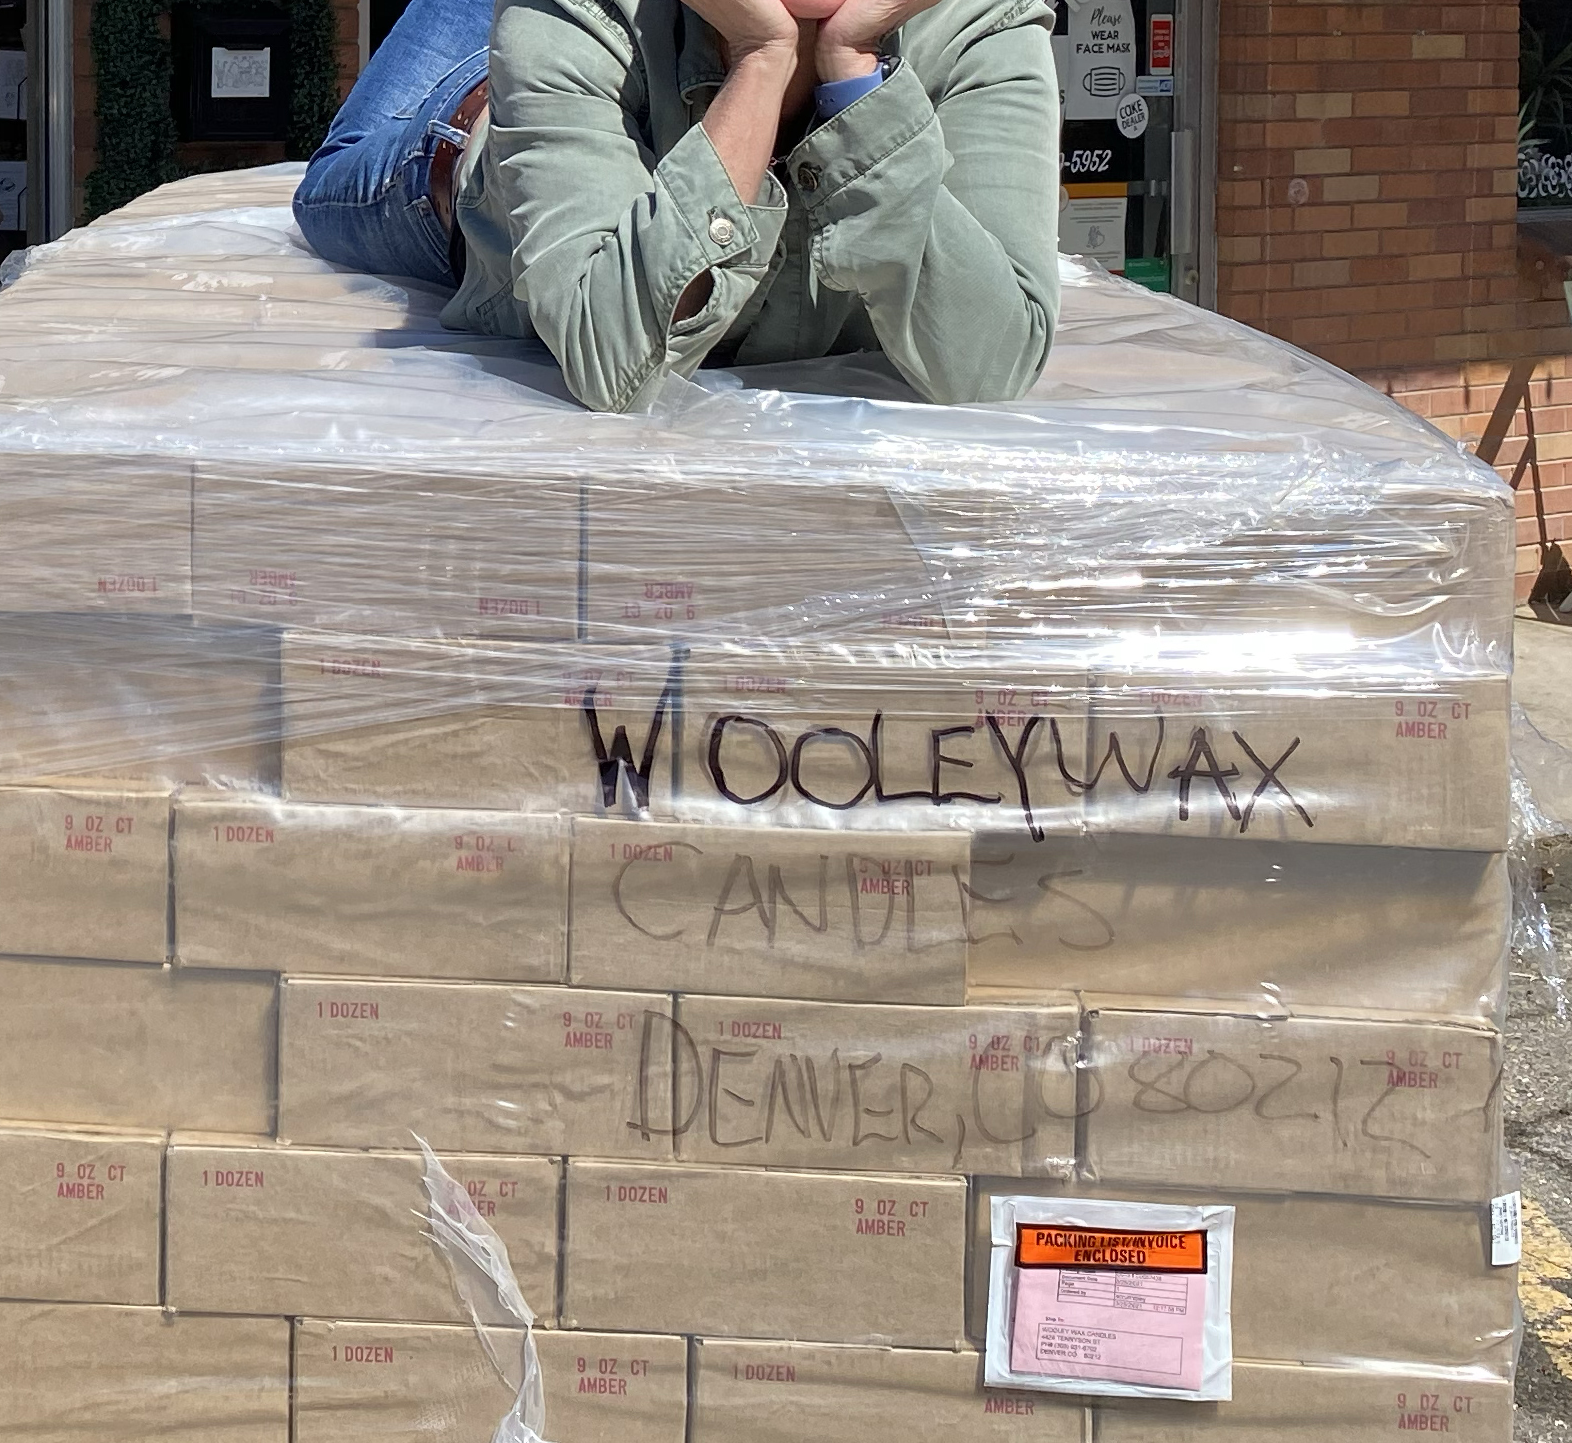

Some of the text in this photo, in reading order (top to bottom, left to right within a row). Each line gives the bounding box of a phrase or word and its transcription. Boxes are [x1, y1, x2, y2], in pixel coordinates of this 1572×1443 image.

[1090, 6, 1122, 26] Please
[1091, 30, 1119, 41] WEAR
[1076, 42, 1131, 54] FACE MASK
[1119, 99, 1143, 120] COKE
[1121, 112, 1146, 130] DEALER
[644, 582, 695, 600] AMBER
[975, 689, 1050, 707] 9 OZ CT
[1394, 700, 1472, 720] 9 OZ CT
[1395, 721, 1448, 739] AMBER
[65, 815, 134, 835] 9 OZ CT
[226, 826, 274, 843] DOZEN
[65, 835, 113, 853] AMBER
[622, 844, 673, 862] DOZEN
[456, 854, 504, 873] AMBER
[859, 859, 934, 877] 9 OZ CT
[860, 877, 911, 896] AMBER
[329, 1003, 379, 1020] DOZEN
[563, 1011, 635, 1031] 9 OZ CT
[731, 1021, 782, 1040] DOZEN
[564, 1031, 614, 1050] AMBER
[969, 1034, 1041, 1053] 9 OZ CT
[1141, 1037, 1193, 1056] DOZEN
[969, 1054, 1019, 1073] AMBER
[1385, 1050, 1462, 1070] 9 OZ CT
[1386, 1069, 1438, 1089] AMBER
[1127, 1049, 1431, 1159] 80212
[56, 1162, 126, 1182] 9 OZ CT
[215, 1170, 264, 1188] DOZEN
[57, 1182, 104, 1200] AMBER
[468, 1181, 487, 1198] OZ
[499, 1182, 518, 1199] CT
[617, 1186, 668, 1204] DOZEN
[854, 1199, 929, 1218] 9 OZ CT
[856, 1219, 906, 1237] AMBER
[1036, 1232, 1187, 1250] PACKING LIST/INVOICE
[1074, 1250, 1146, 1264] ENCLOSED
[344, 1346, 394, 1363] DOZEN
[577, 1357, 650, 1377] 9 OZ CT
[745, 1365, 796, 1382] DOZEN
[578, 1377, 627, 1395] AMBER
[984, 1397, 1035, 1415] AMBER
[1397, 1392, 1474, 1413] 9 OZ CT
[1398, 1413, 1450, 1432] AMBER
